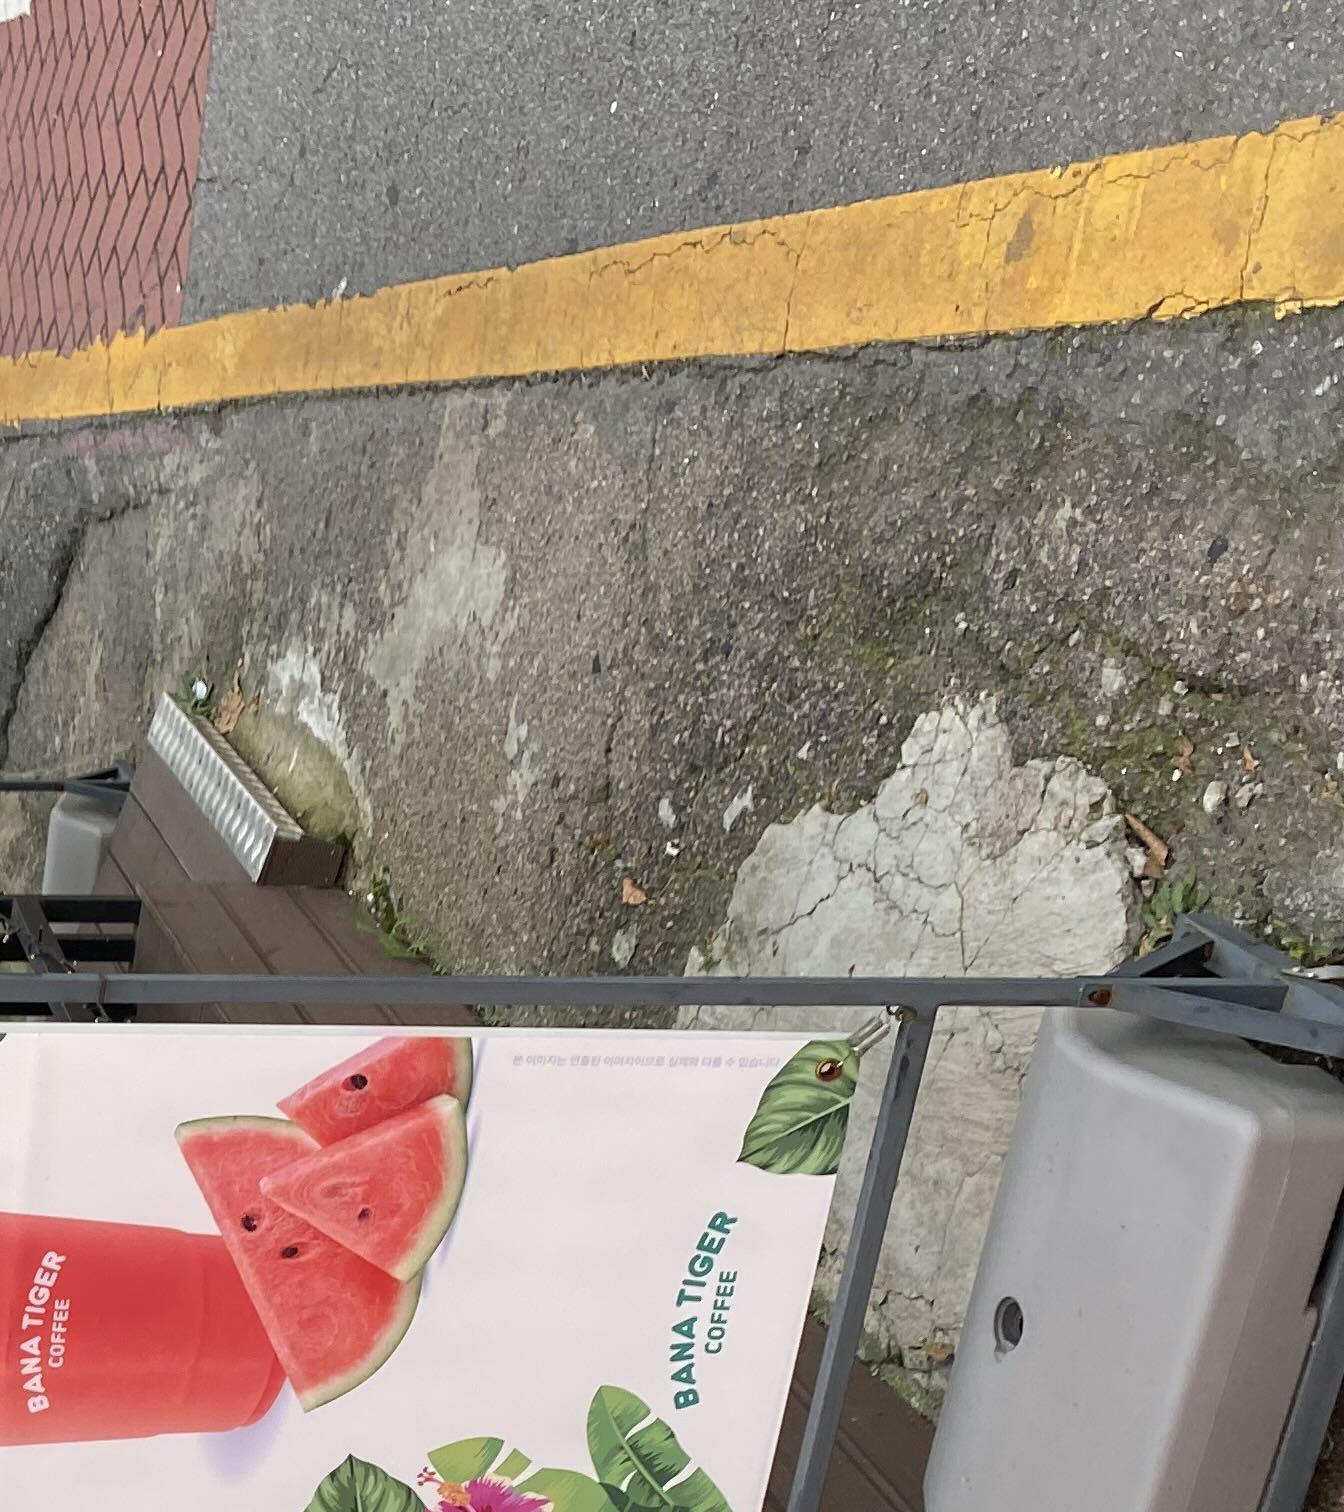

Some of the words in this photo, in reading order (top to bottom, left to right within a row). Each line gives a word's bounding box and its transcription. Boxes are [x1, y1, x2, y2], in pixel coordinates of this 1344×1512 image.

[20, 1250, 67, 1331] TIGER
[675, 1210, 739, 1308] TIGER
[47, 1298, 71, 1369] COFFEE
[703, 1270, 738, 1355] COFFEE
[19, 1335, 50, 1414] BANA
[669, 1315, 700, 1410] BANA
